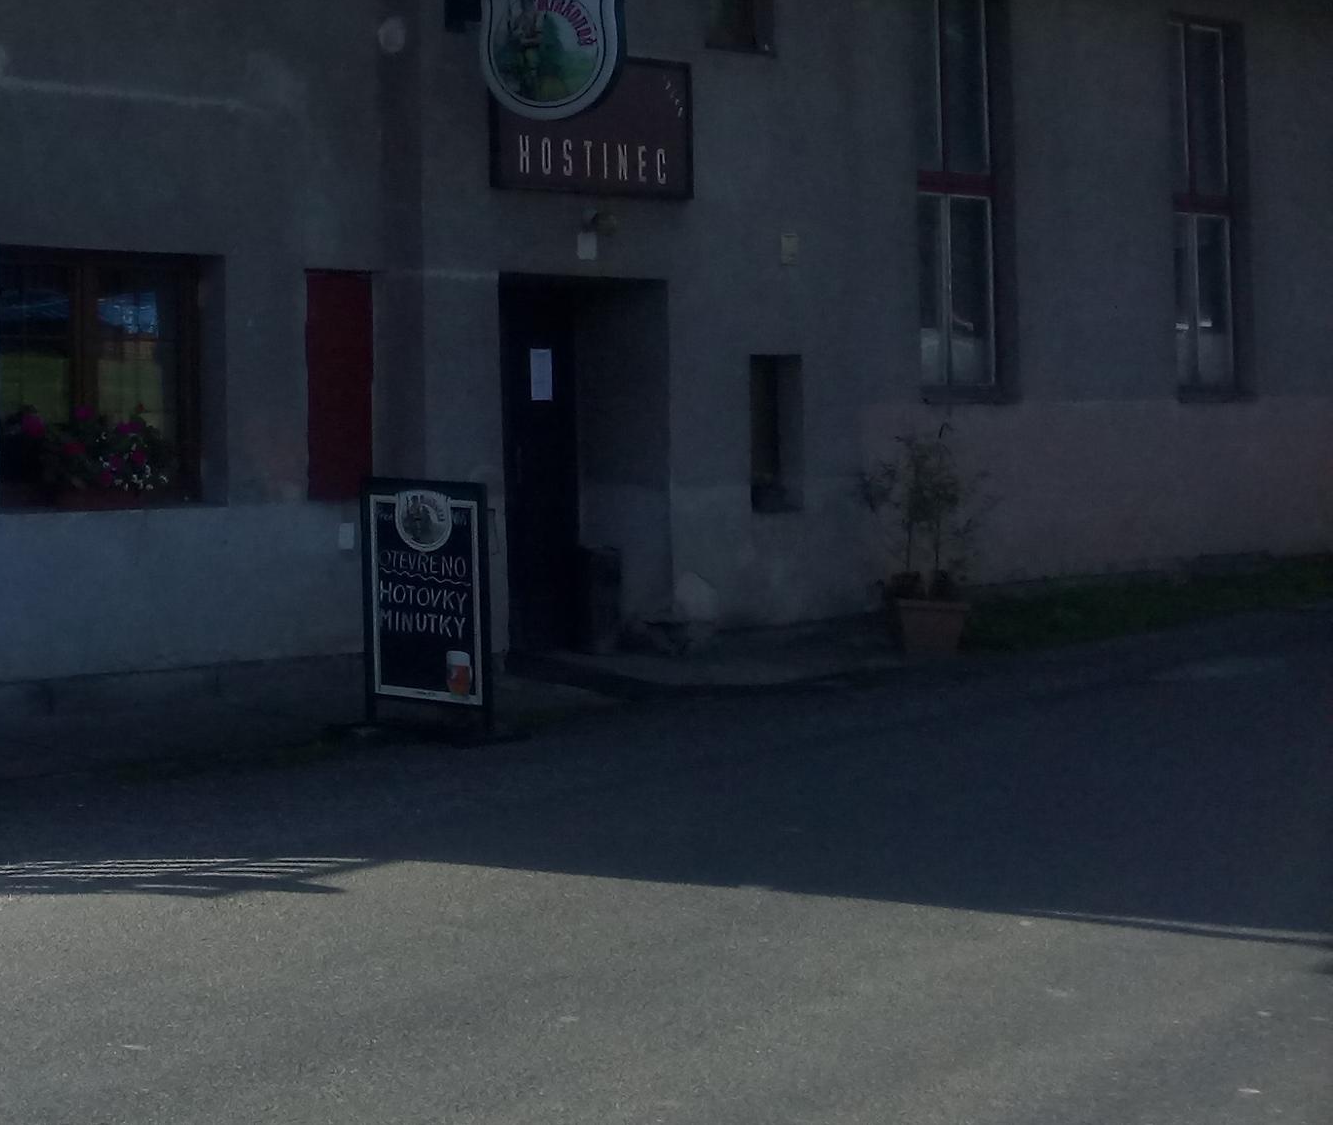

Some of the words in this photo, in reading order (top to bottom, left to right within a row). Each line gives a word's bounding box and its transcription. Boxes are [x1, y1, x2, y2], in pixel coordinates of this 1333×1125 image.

[519, 134, 667, 185] HOSTINEC
[379, 579, 468, 615] HOTOVKY
[380, 608, 466, 640] MINUTKY
